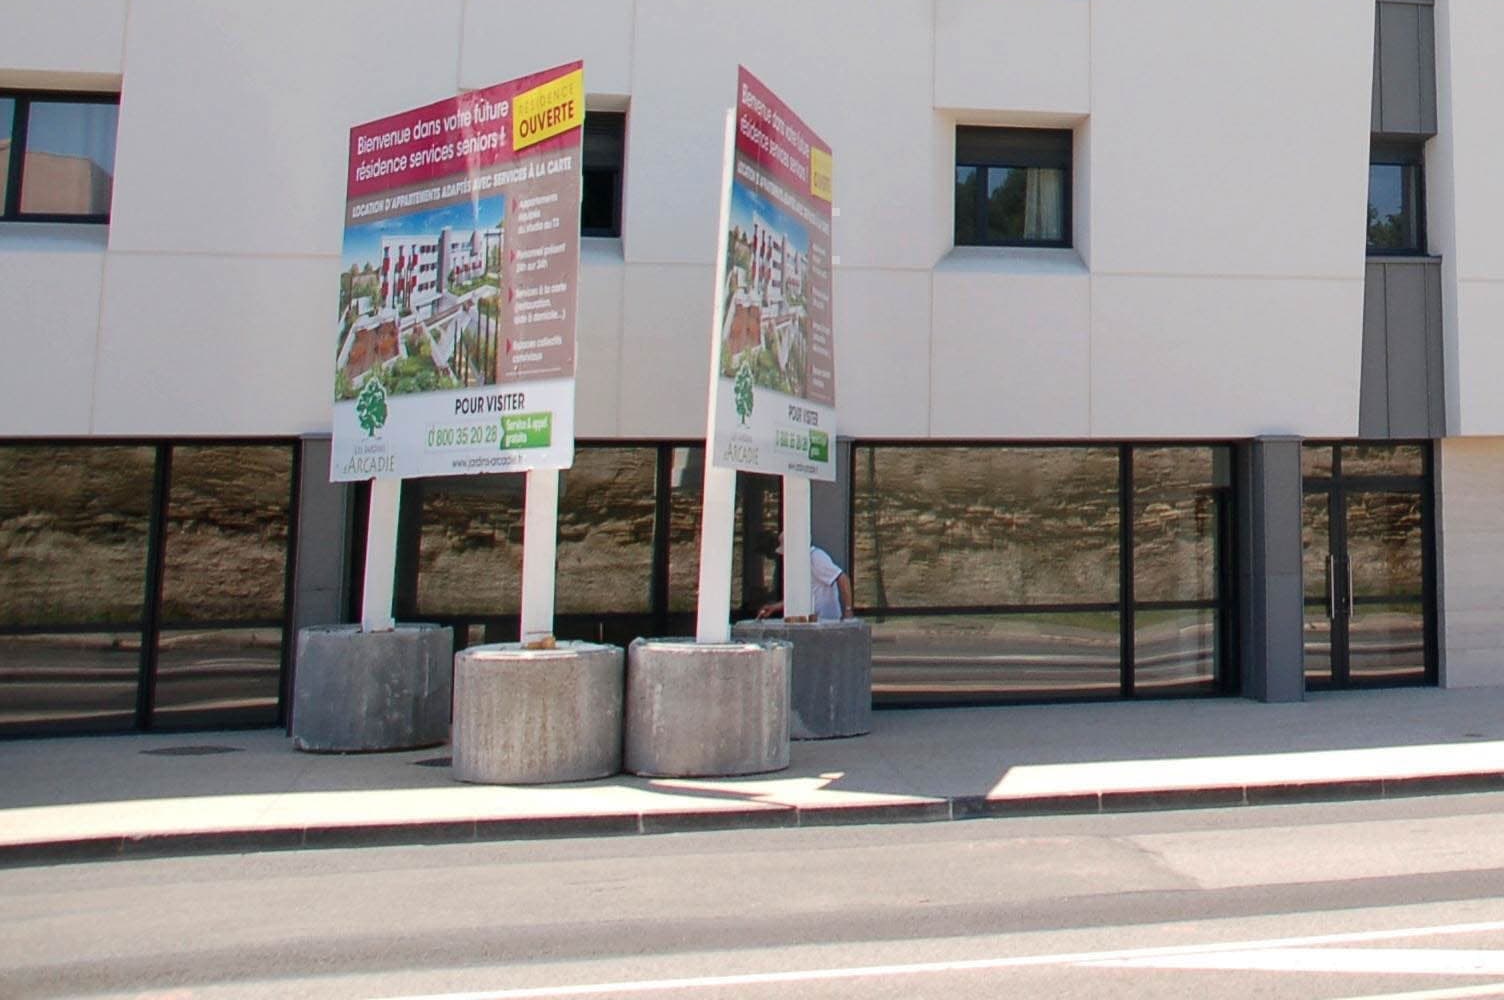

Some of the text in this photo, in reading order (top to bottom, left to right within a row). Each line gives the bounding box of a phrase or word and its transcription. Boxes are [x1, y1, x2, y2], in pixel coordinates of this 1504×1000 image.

[357, 99, 509, 156] Bienvenue dans votre future
[519, 100, 575, 138] OUVERTE
[356, 152, 408, 181] résidence
[409, 142, 455, 168] services
[456, 131, 498, 156] seniors
[352, 199, 384, 218] LOCATION
[472, 174, 492, 191] AVEC
[493, 167, 527, 187] SERVICES
[536, 163, 545, 177] LA
[547, 156, 572, 174] CARTE
[455, 392, 525, 415] POUR VISITER
[436, 428, 454, 446] 800
[456, 427, 468, 445] 35
[470, 426, 482, 443] 20
